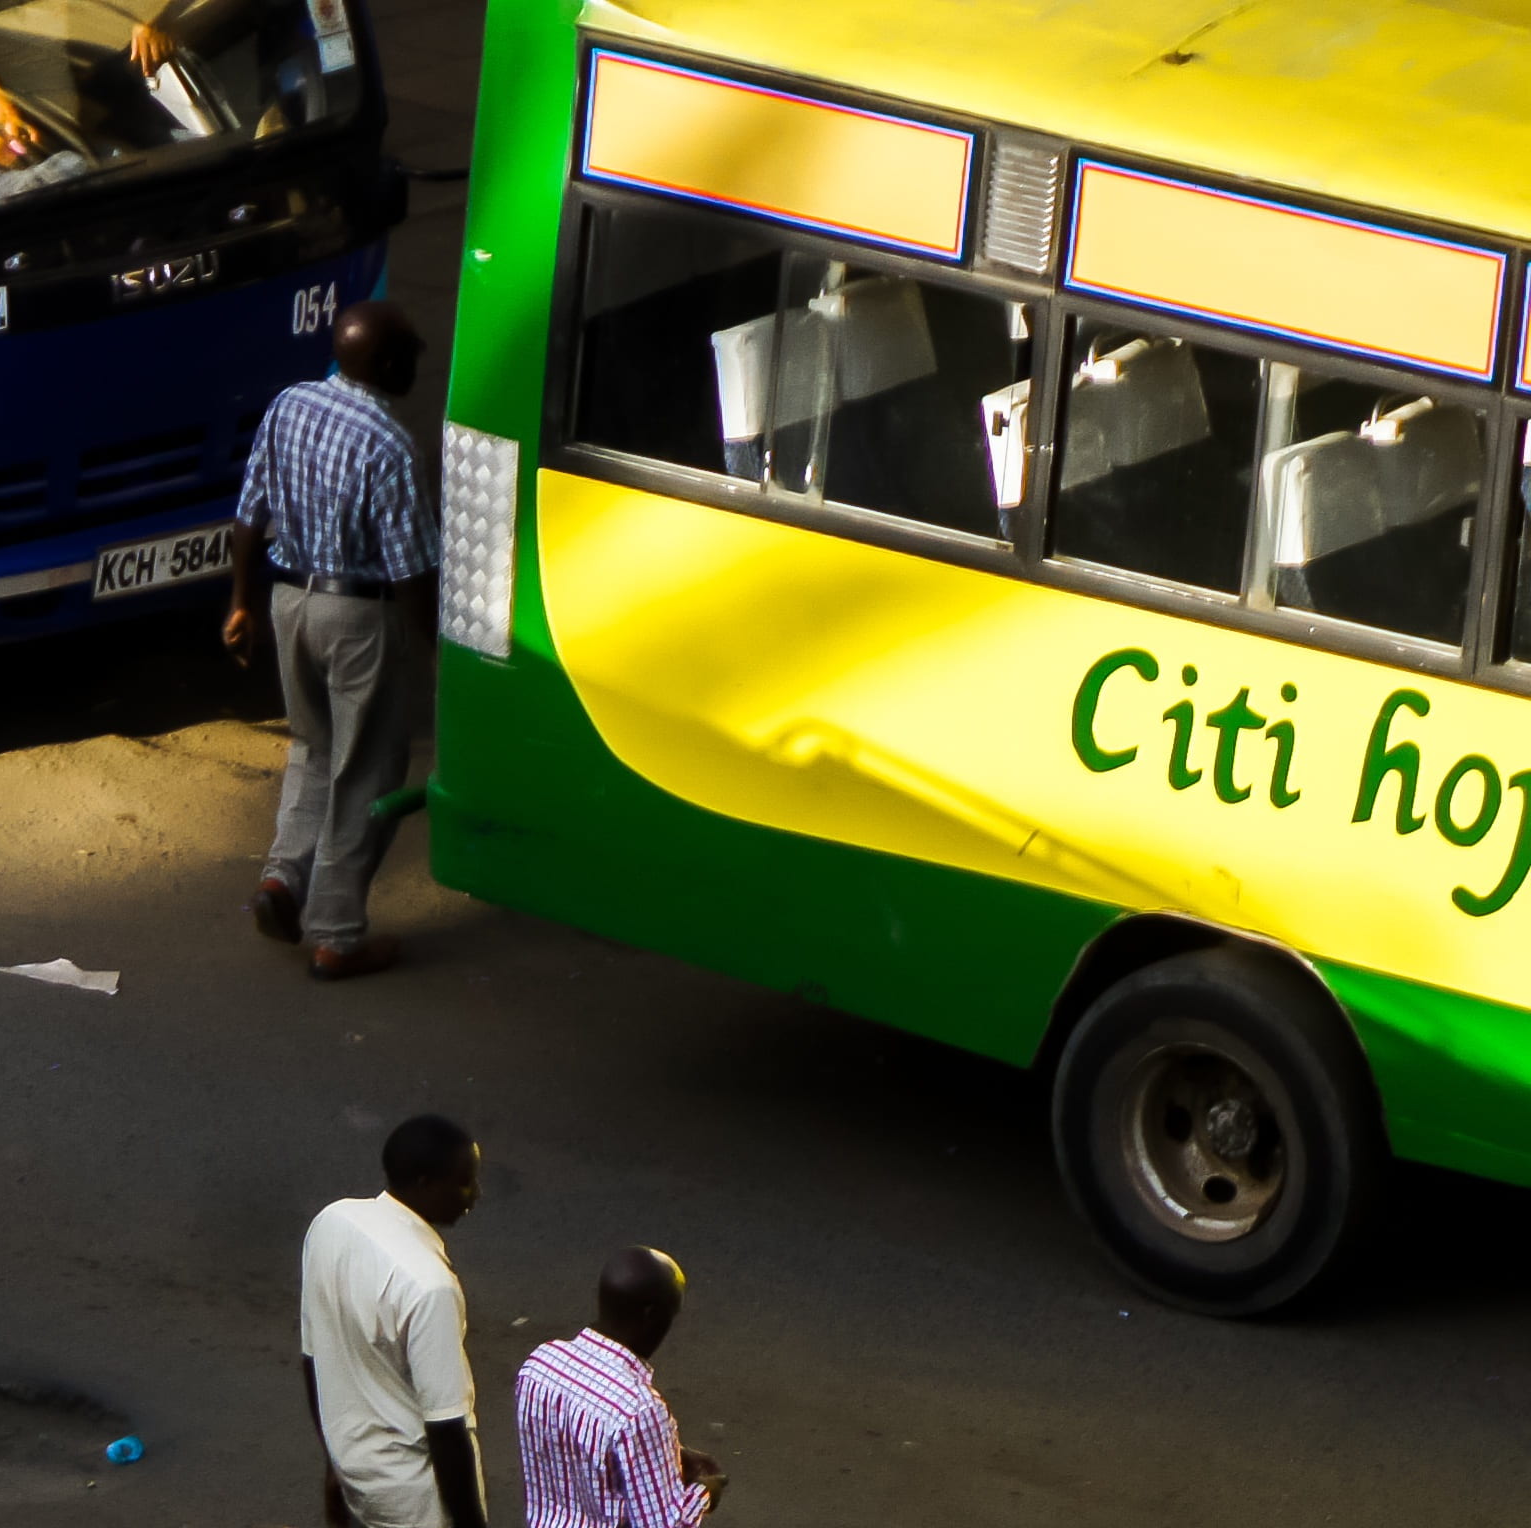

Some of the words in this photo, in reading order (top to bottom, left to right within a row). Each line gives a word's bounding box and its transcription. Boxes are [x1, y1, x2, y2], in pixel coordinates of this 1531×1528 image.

[111, 250, 218, 298] ISUZU
[292, 281, 337, 335] 054
[98, 546, 157, 593] KCH
[1072, 648, 1301, 809] Citi
